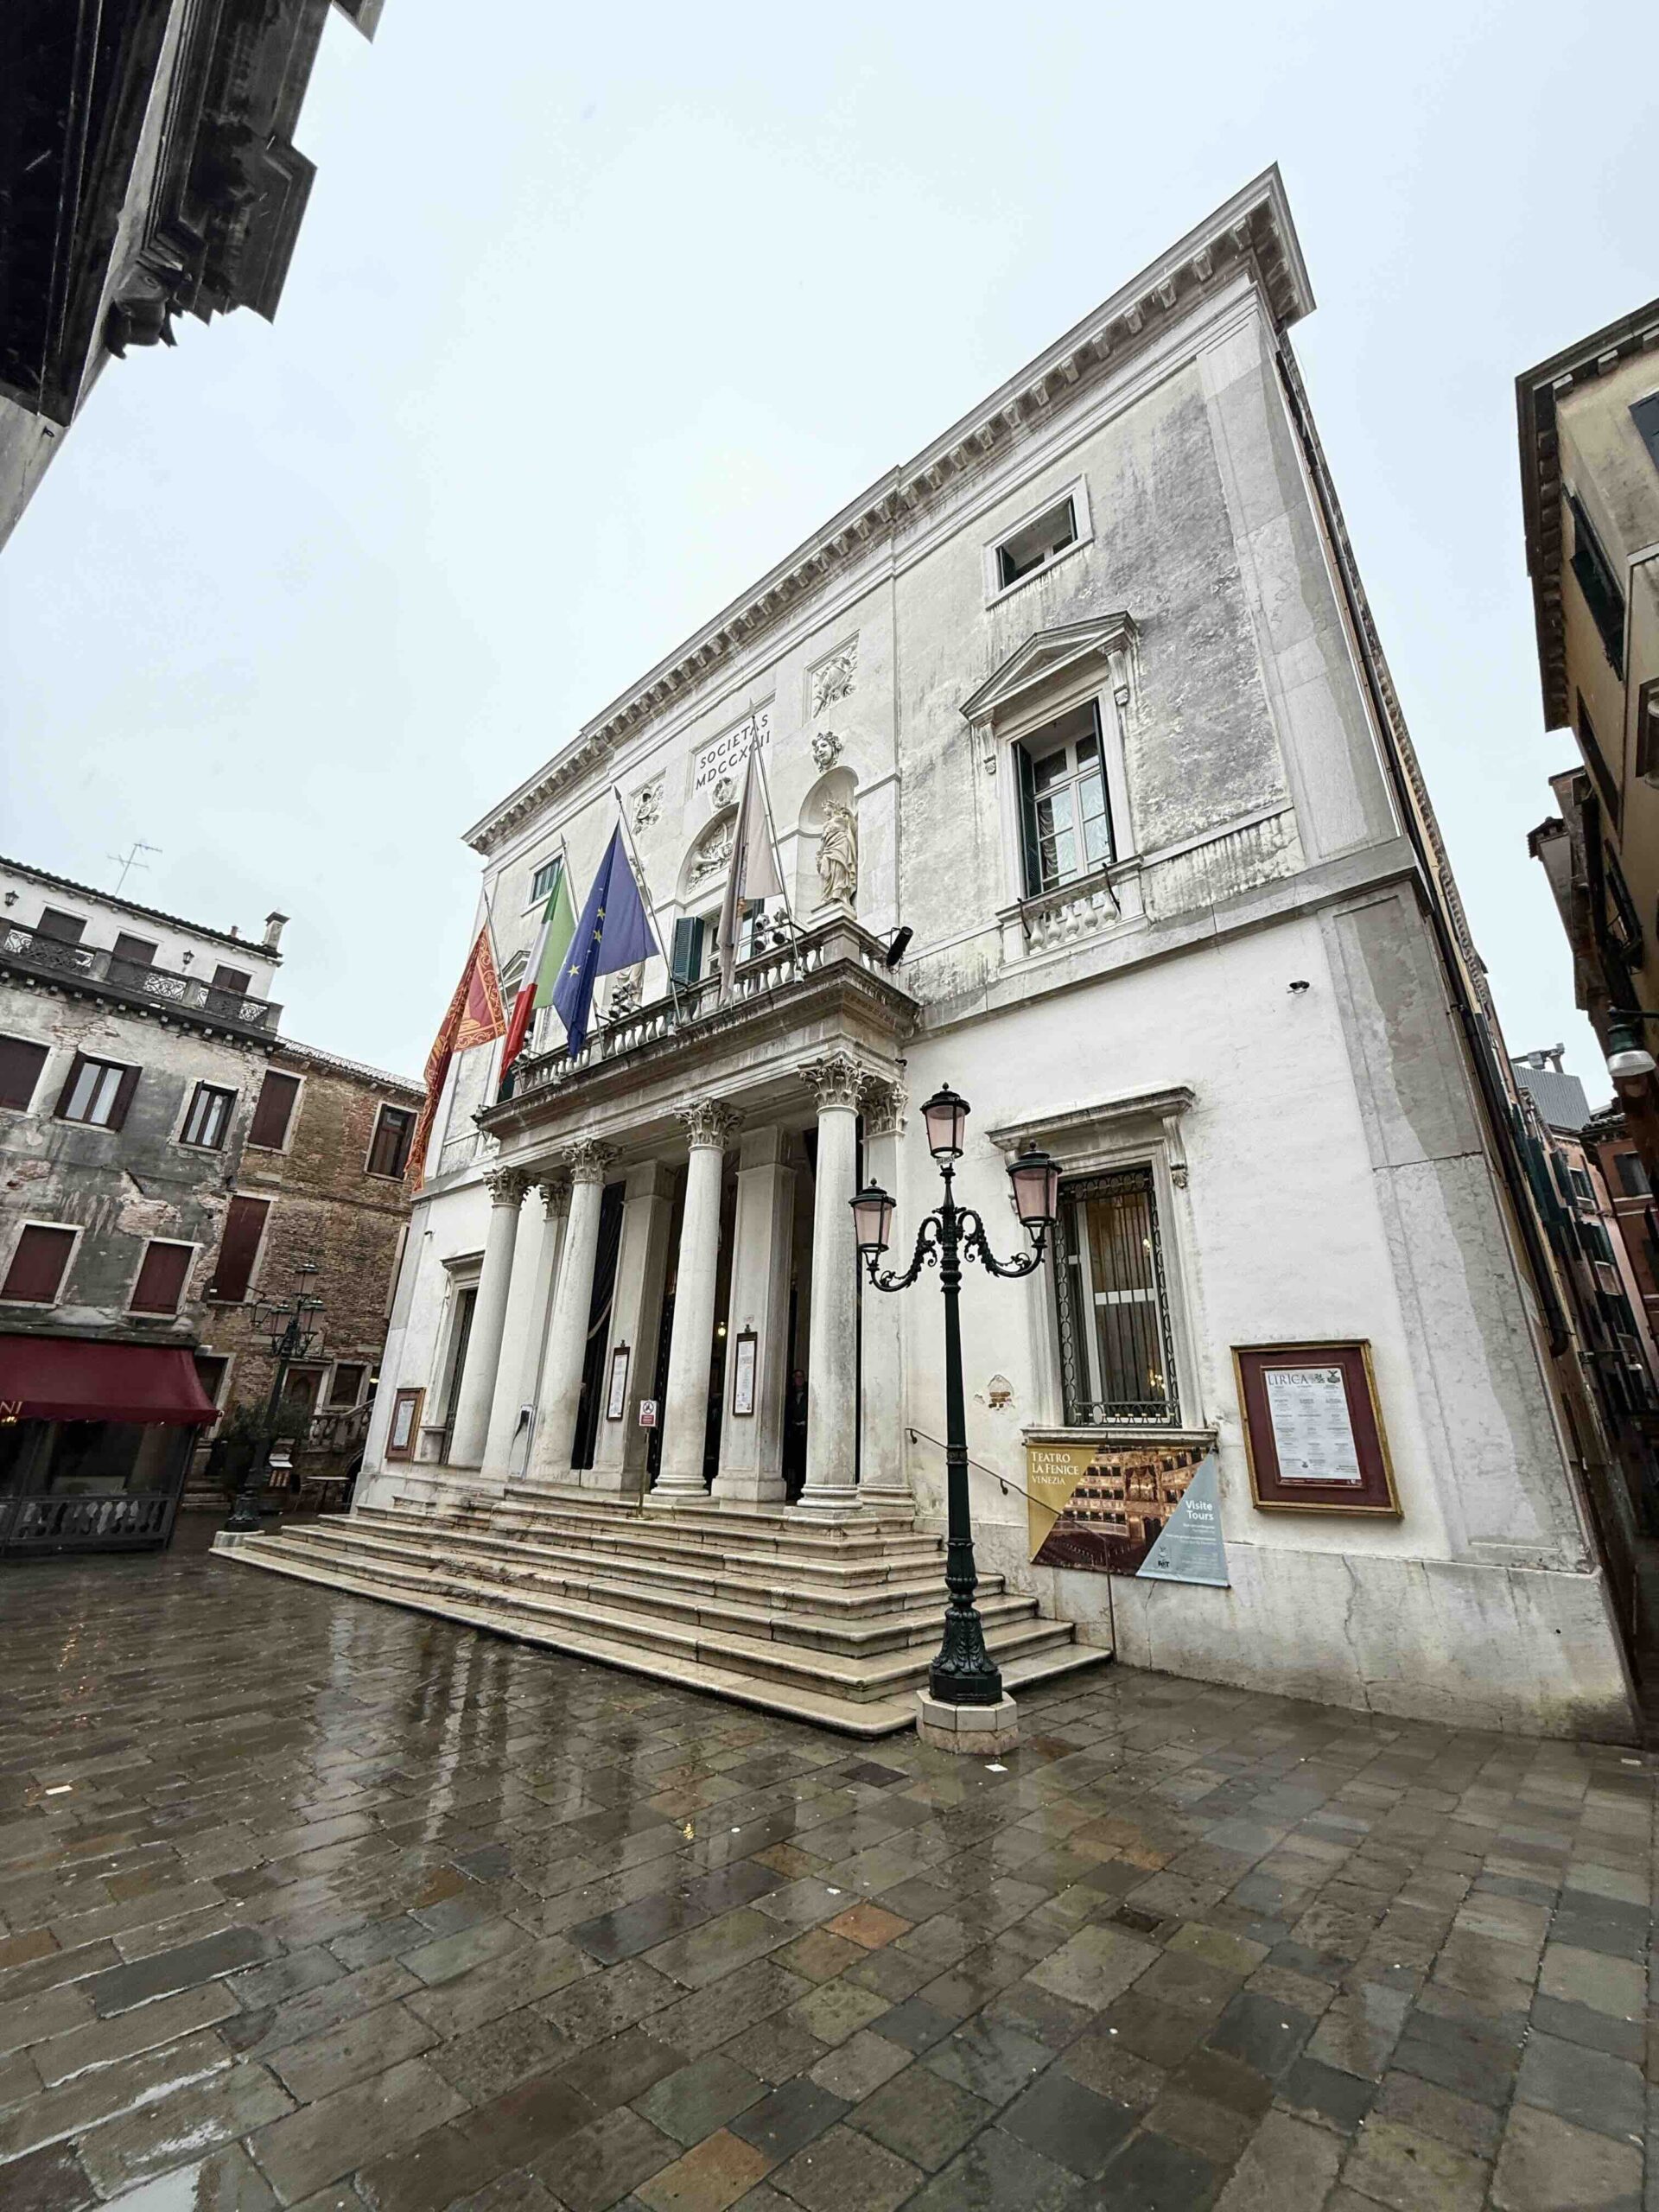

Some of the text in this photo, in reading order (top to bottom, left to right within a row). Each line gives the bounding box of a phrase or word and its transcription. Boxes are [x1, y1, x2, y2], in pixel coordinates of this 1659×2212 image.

[700, 714, 768, 769] SOCIETAS
[1268, 1373, 1309, 1385] LIRICA
[1031, 1452, 1071, 1463] TEATRO
[1032, 1462, 1079, 1475] LA FENICE
[1032, 1475, 1066, 1485] VENEZIA
[1185, 1500, 1213, 1511] Visite
[1186, 1510, 1214, 1521] Tours
